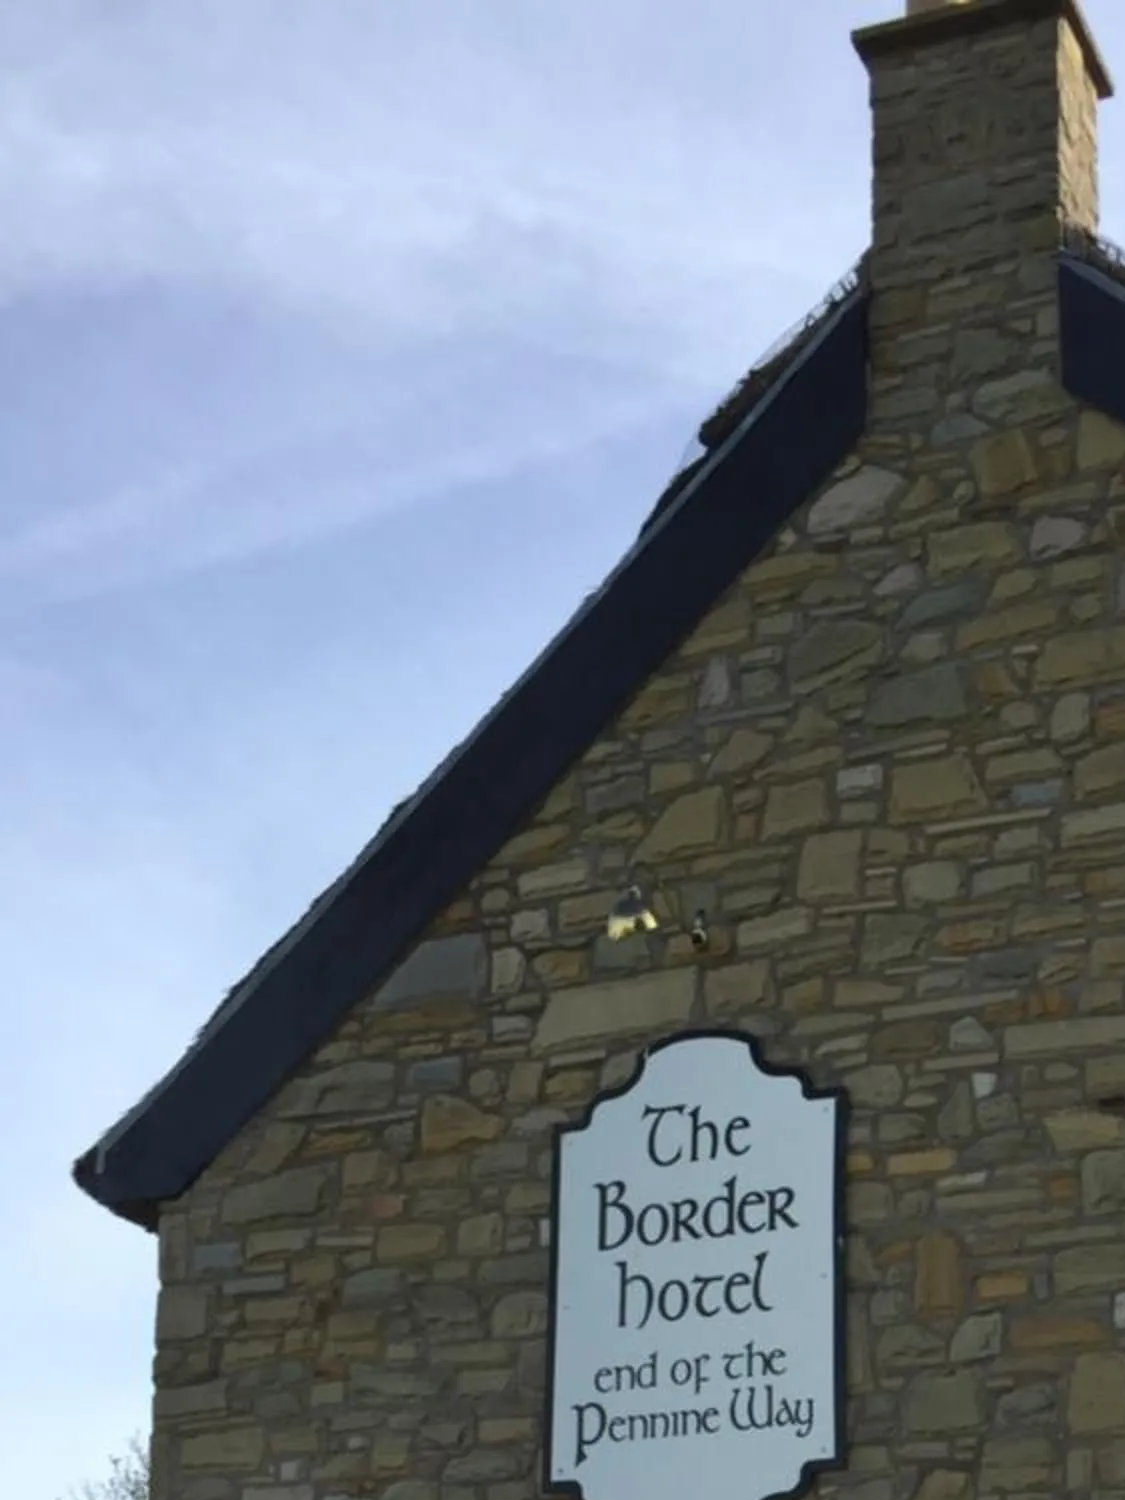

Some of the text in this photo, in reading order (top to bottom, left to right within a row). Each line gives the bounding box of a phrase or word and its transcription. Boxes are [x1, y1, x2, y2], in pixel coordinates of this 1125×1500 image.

[641, 1103, 752, 1168] The
[593, 1341, 787, 1395] end of the
[729, 1384, 815, 1439] Way
